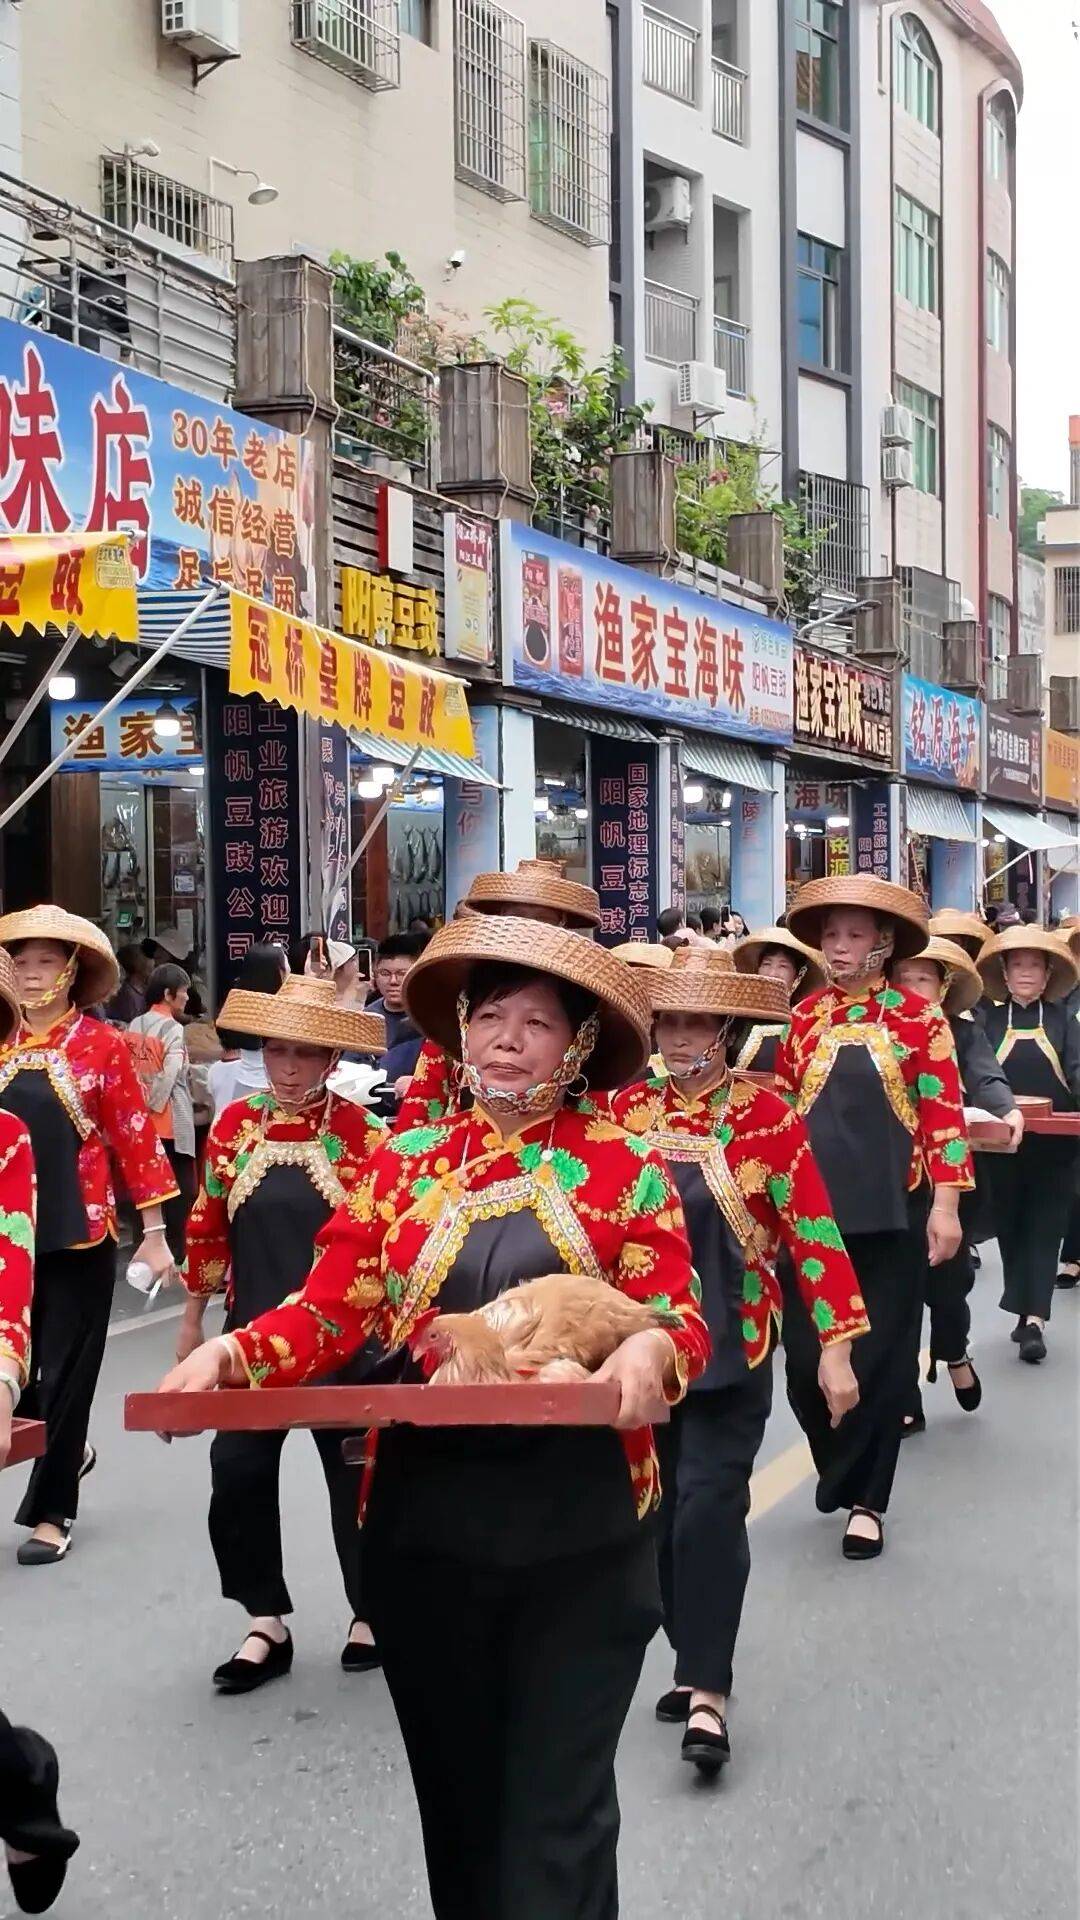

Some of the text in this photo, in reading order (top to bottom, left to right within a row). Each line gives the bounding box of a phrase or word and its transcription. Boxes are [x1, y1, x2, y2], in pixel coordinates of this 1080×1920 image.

[0, 342, 152, 584] 味店
[171, 410, 297, 492] 30年老店
[172, 476, 297, 560] 诚信经营
[593, 581, 746, 713] 渔家宝海味
[222, 704, 254, 961] 阳帆豆豉公司
[600, 777, 626, 935] 阳帆豆豉
